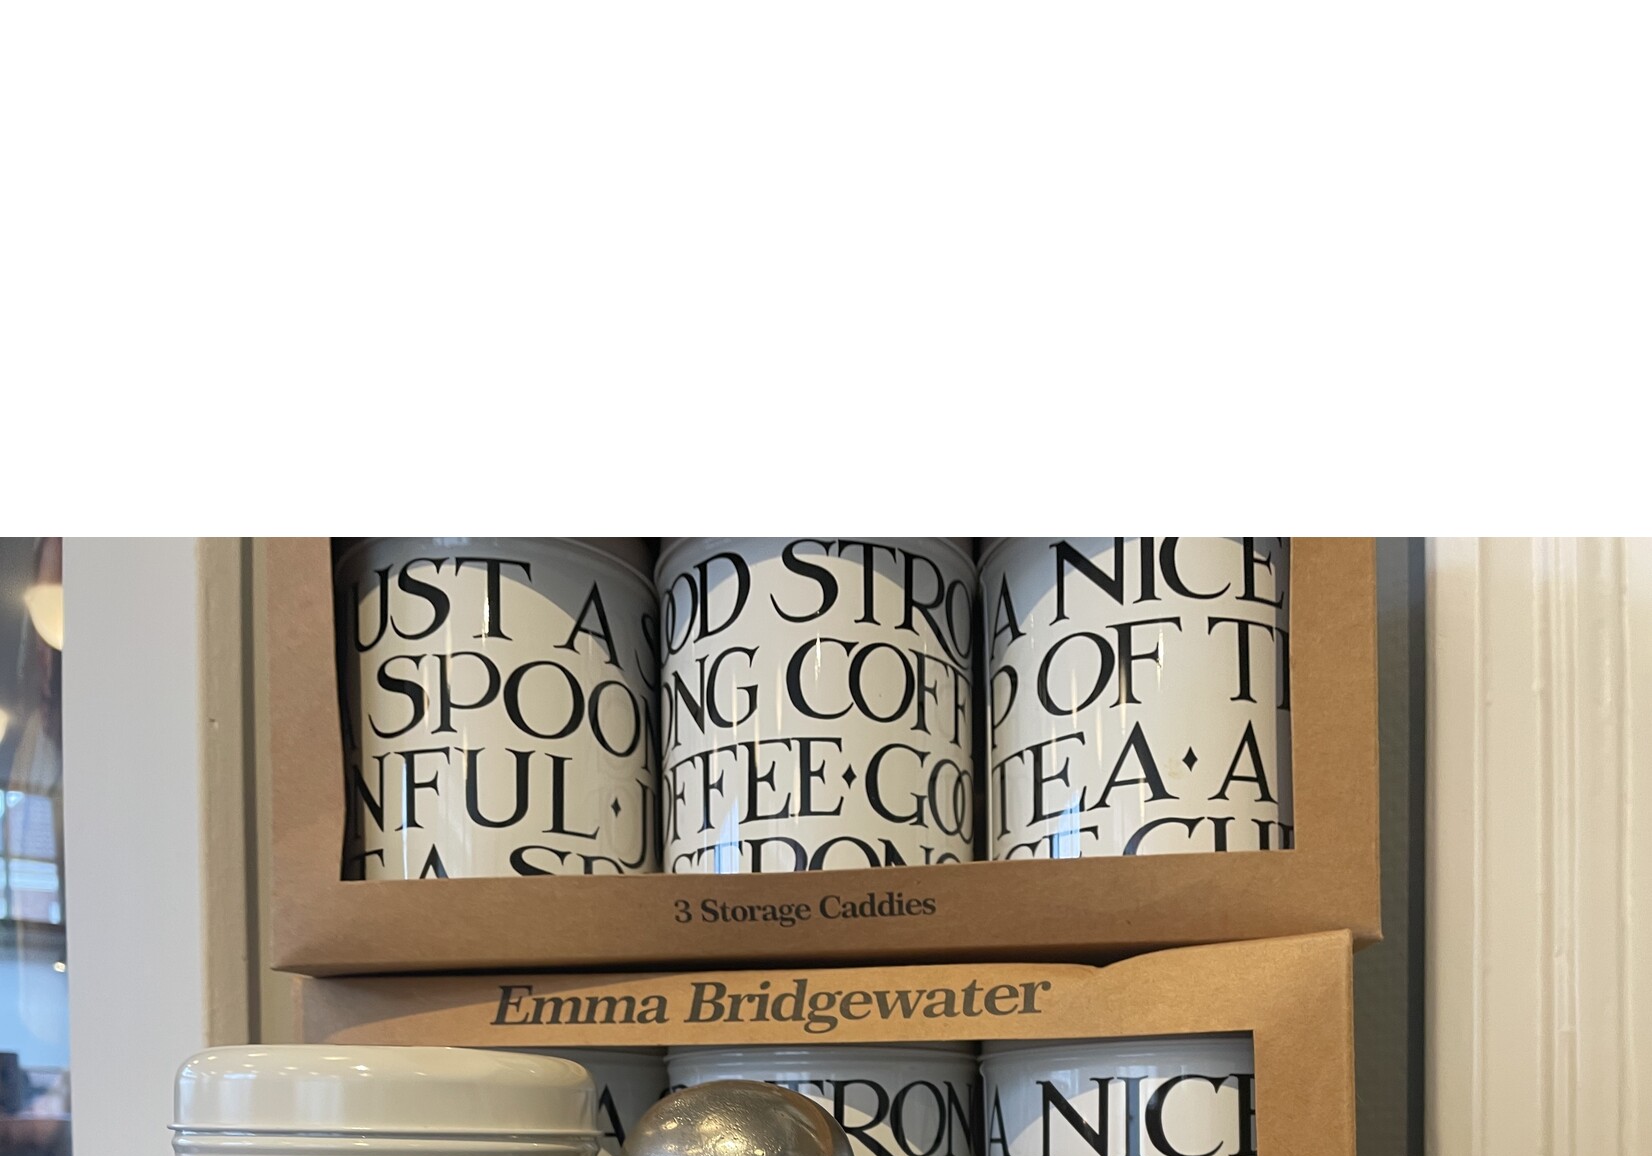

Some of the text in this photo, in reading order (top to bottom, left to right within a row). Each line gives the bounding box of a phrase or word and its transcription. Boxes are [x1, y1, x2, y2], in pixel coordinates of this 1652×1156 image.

[554, 580, 624, 671] A
[1049, 537, 1285, 626] NICE
[1037, 616, 1182, 716] OF
[992, 720, 1180, 841] TEA
[1207, 719, 1279, 804] A
[674, 891, 937, 928] 3 Storage Caddies
[490, 978, 1052, 1034] Emma Bridgewater
